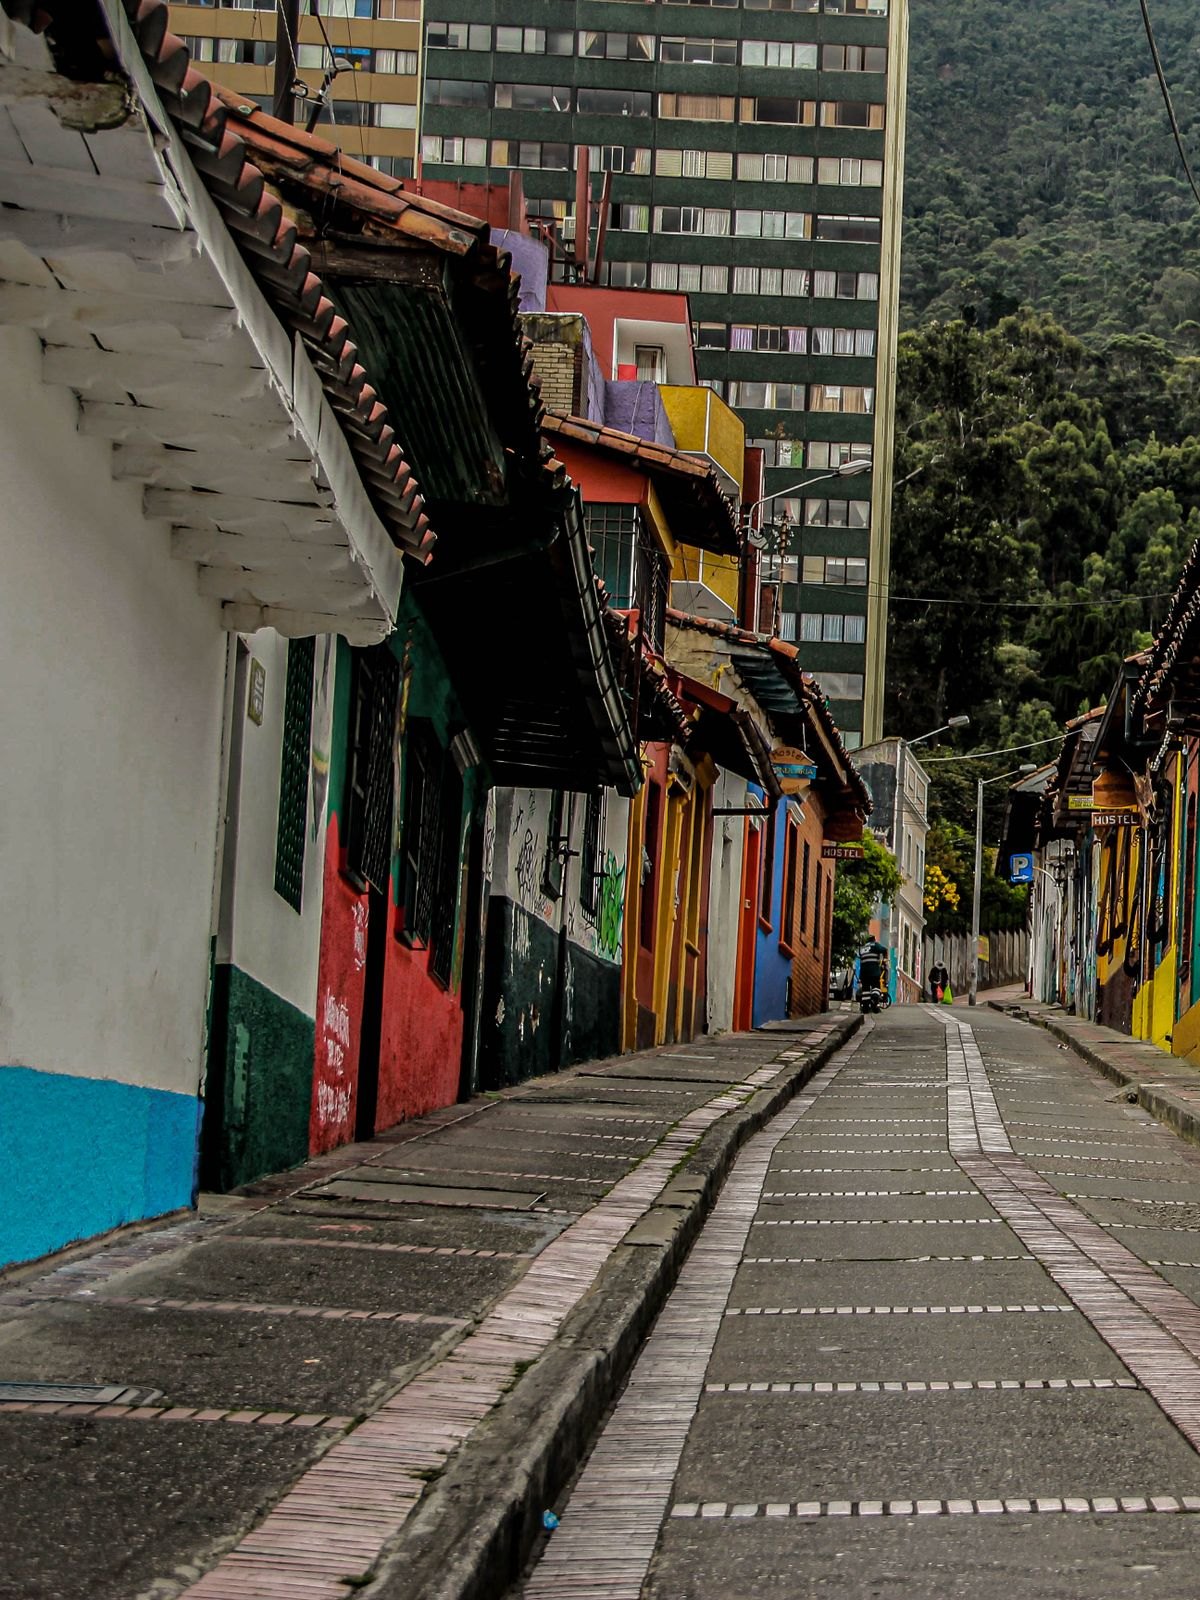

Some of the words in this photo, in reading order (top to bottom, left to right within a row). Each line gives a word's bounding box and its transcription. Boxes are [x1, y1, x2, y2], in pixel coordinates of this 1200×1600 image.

[1094, 814, 1137, 825] HOSTEL
[823, 848, 862, 858] HOSTEL
[1012, 857, 1029, 876] P
